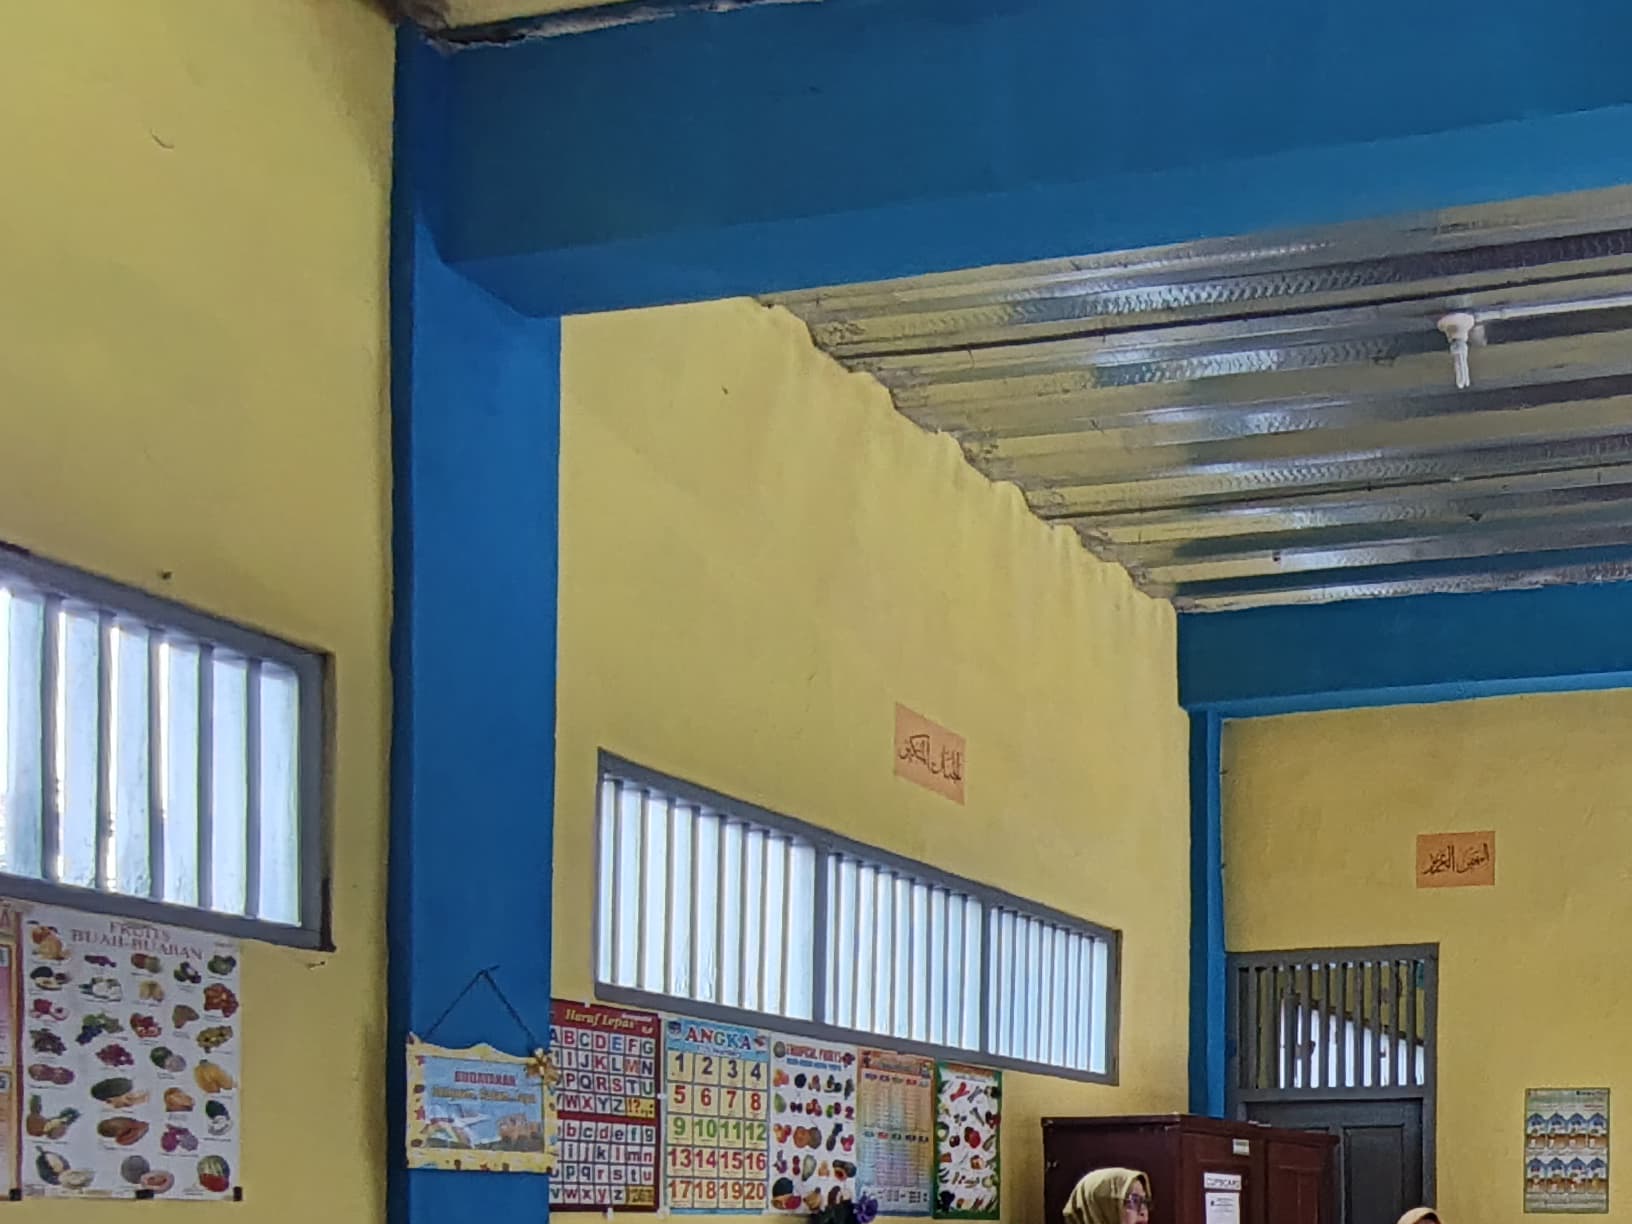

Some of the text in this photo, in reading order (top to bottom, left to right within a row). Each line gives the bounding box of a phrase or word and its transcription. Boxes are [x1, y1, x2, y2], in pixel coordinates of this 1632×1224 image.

[564, 1030, 575, 1045] B
[580, 1032, 590, 1047] C
[595, 1034, 606, 1049] D
[612, 1036, 622, 1051] E
[628, 1038, 637, 1052] F
[642, 1041, 653, 1055] G
[684, 1026, 752, 1050] ANGKA
[566, 1051, 653, 1075] I J K L M N
[674, 1053, 761, 1081] 1 2 3 4
[566, 1073, 653, 1095] P Q R S T U
[564, 1094, 577, 1109] W
[582, 1095, 593, 1110] X
[597, 1097, 609, 1112] Y
[613, 1099, 625, 1113] Z
[673, 1084, 761, 1111] 5 6 7 8
[566, 1122, 576, 1138] b
[582, 1127, 593, 1139] c
[600, 1125, 609, 1140] d
[614, 1129, 624, 1141] e
[644, 1128, 654, 1143] g
[673, 1116, 767, 1141] 9 10 11 12
[567, 1143, 574, 1159] i
[596, 1146, 606, 1160] k
[628, 1151, 640, 1162] m
[643, 1152, 653, 1162] n
[668, 1147, 767, 1171] 13 14 15 16
[566, 1165, 576, 1180] p
[581, 1165, 591, 1180] q
[597, 1168, 605, 1180] r
[613, 1169, 623, 1181] s
[643, 1170, 653, 1181] u
[550, 1188, 560, 1199] v
[564, 1188, 577, 1199] w
[581, 1188, 591, 1200] x
[598, 1188, 607, 1203] y
[614, 1189, 623, 1201] z
[668, 1179, 693, 1199] 17
[694, 1180, 717, 1200] 18
[720, 1181, 744, 1201] 19
[744, 1182, 768, 1201] 20
